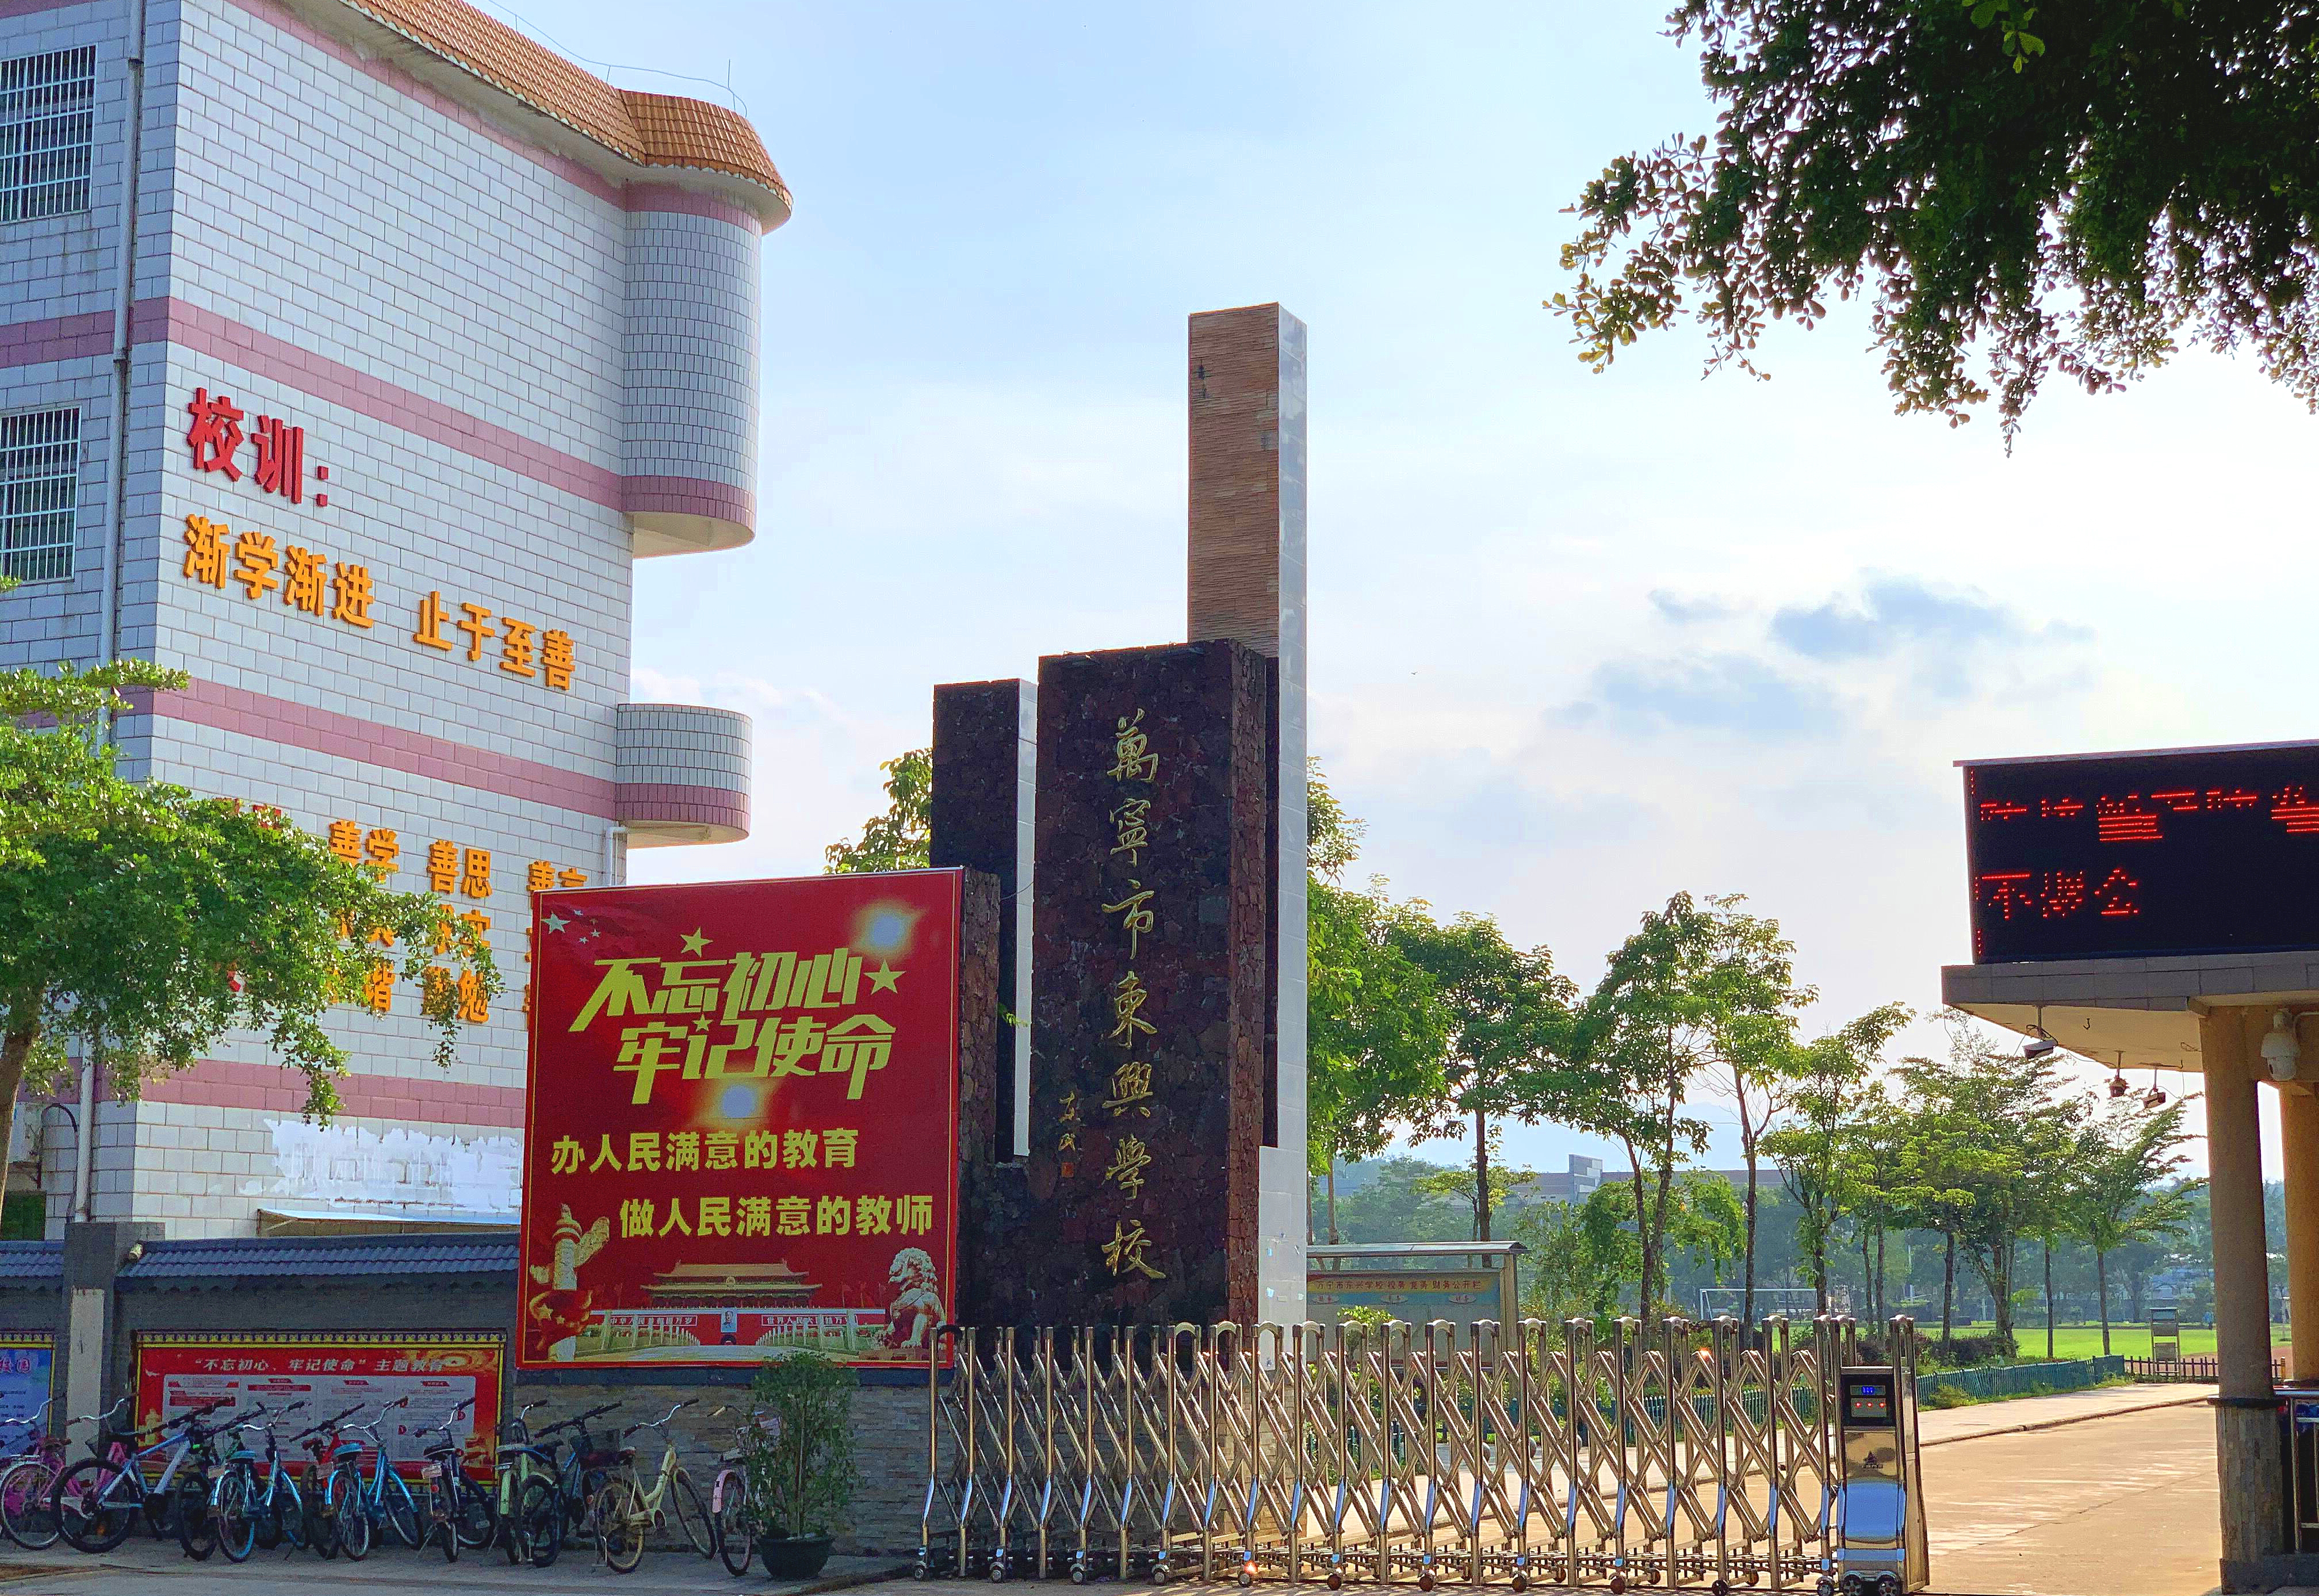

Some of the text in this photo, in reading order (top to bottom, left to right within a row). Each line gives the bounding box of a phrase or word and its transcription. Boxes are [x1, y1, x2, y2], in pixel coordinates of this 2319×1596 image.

[183, 513, 576, 691] 渐学渐进 止于至善
[427, 839, 492, 900] 善思
[568, 947, 864, 1033] 不忘初心
[613, 1013, 897, 1105] 牢记使命
[550, 1127, 859, 1176] 办人民满意的教育
[619, 1194, 934, 1239] 做人民满意的教师
